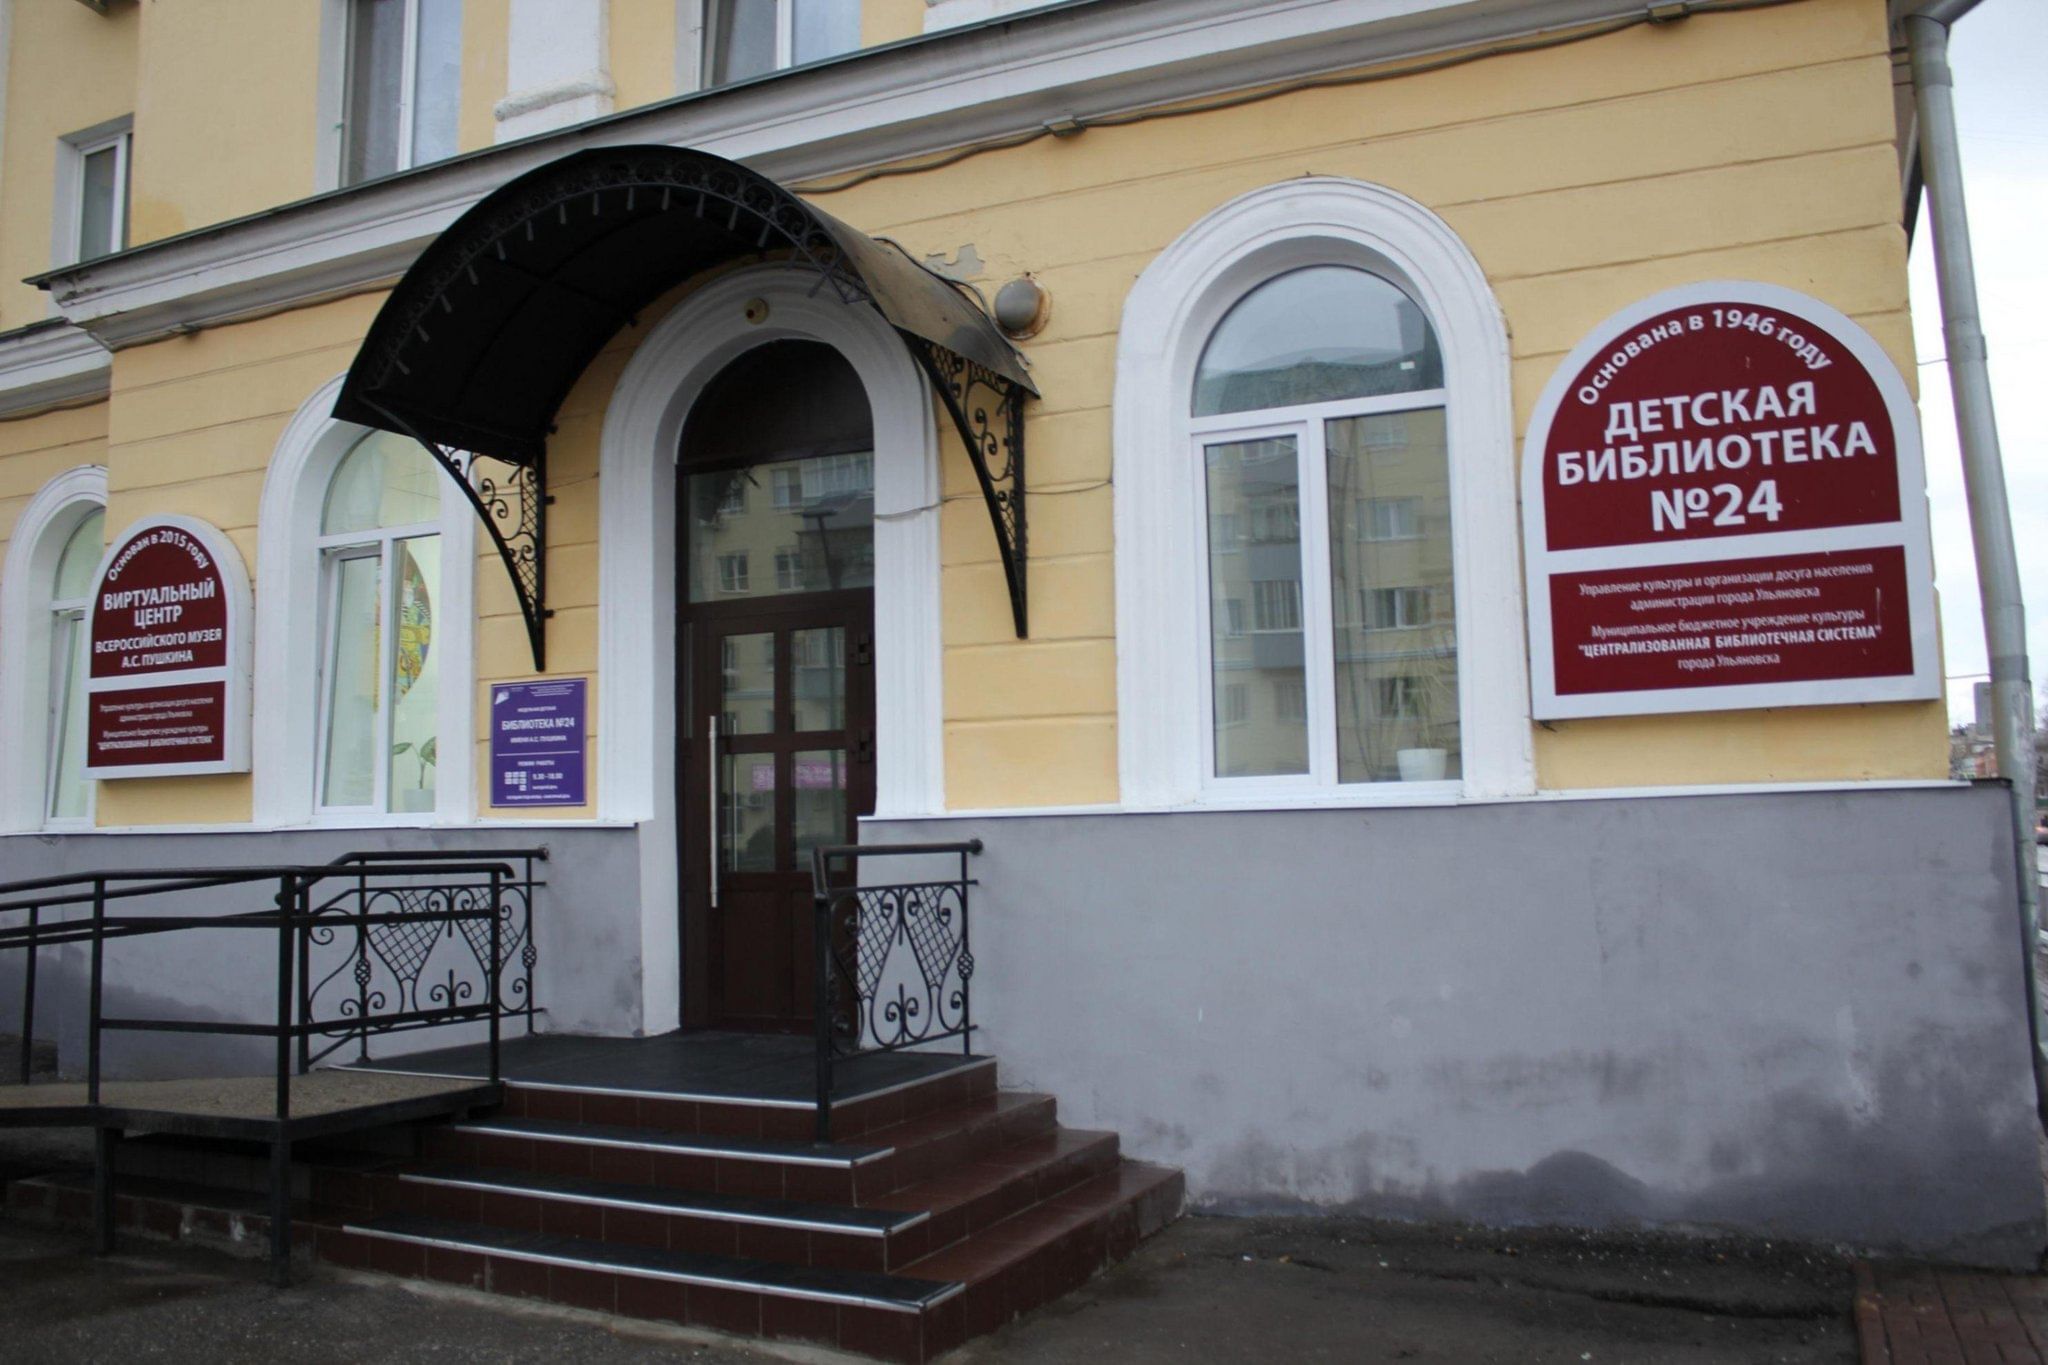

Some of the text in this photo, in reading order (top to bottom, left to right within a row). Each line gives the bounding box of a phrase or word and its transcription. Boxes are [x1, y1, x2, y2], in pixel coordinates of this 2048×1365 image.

[1579, 309, 1833, 405] Основана в 1946 году
[1604, 381, 1816, 443] ДЕТСКАЯ
[1557, 421, 1877, 486] БИБЛИОТЕКА
[1651, 480, 1783, 531] №24
[108, 530, 210, 582] Основан в 2015 году
[103, 578, 215, 611] ВИРТУАЛЬНЫЙ
[1579, 563, 1873, 597] Управление культуры и организации досуга населения
[1630, 587, 1821, 612] администрации города Ульяновска
[134, 605, 183, 629] ЦЕНТР
[1591, 609, 1865, 638] Муниципальное бюджетное учреждение культуры
[95, 627, 222, 653] ВСЕРОССИЙСКОГО МУЗЕЯ
[1578, 624, 1882, 658] "ЦЕНТРАЛИЗОВАННАЯ БИБЛИОТЕЧНАЯ СИСТЕМА"
[121, 650, 193, 668] А.С. ПУШКИНА
[1678, 653, 1780, 671] города Ульяновска
